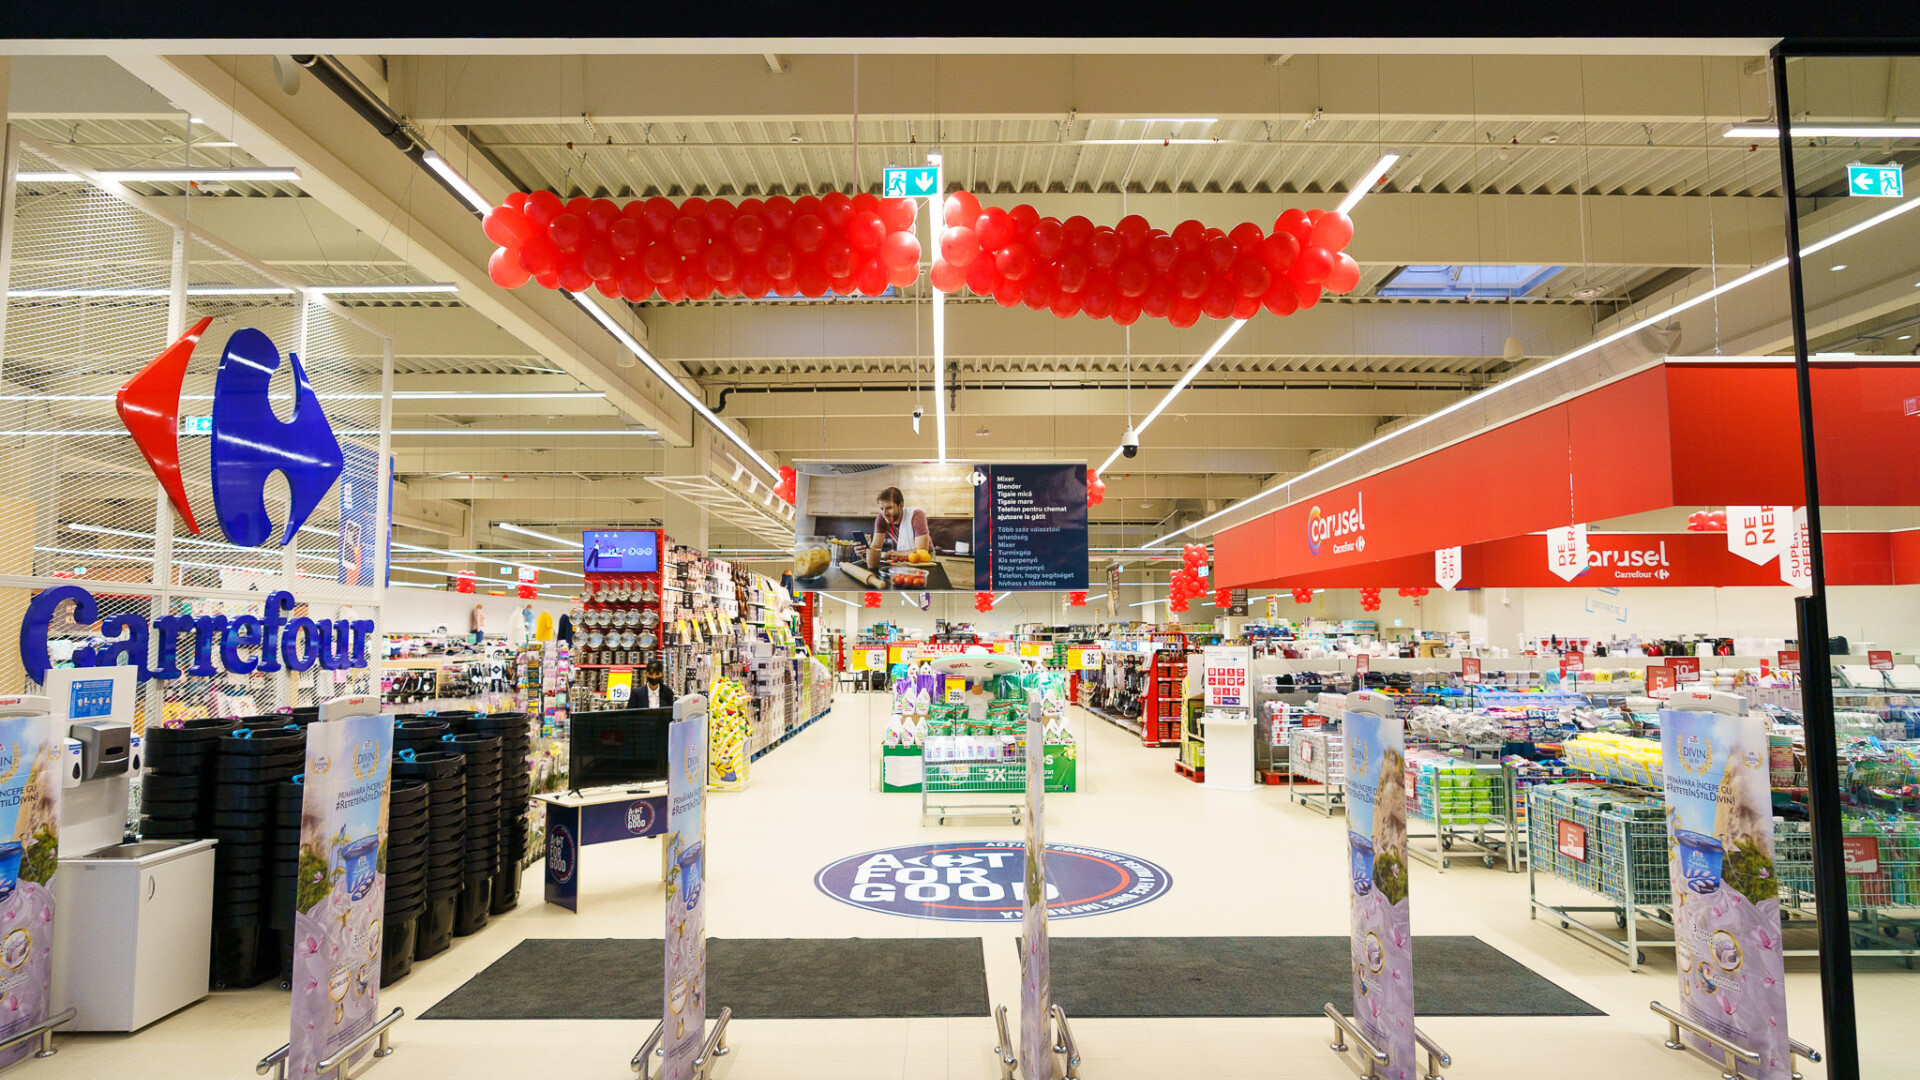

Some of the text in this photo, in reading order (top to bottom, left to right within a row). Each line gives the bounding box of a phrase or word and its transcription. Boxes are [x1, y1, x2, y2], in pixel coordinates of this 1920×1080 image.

[1744, 516, 1757, 546] DE
[1332, 541, 1355, 555] Carrefour
[1587, 541, 1670, 567] arusel
[1558, 544, 1566, 567] DE
[1041, 572, 1075, 580] segítséget
[1614, 570, 1652, 579] Carrefour
[20, 585, 375, 687] Carrefour
[1675, 664, 1689, 675] 10
[1655, 676, 1664, 690] 5
[612, 688, 622, 698] 19
[357, 752, 375, 765] DIVIN
[1683, 746, 1706, 759] DIVIN
[0, 755, 13, 768] IN
[985, 768, 1007, 782] 3X
[0, 786, 25, 797] NCEPE
[627, 820, 646, 829] GOOD
[628, 814, 641, 823] FOR
[1567, 833, 1574, 847] 5
[550, 846, 562, 859] FOR
[1053, 845, 1125, 862] CONCRETE
[1844, 849, 1856, 863] 5
[549, 857, 567, 873] GOOD
[853, 867, 993, 885] FOR
[848, 882, 1061, 903] GOOD
